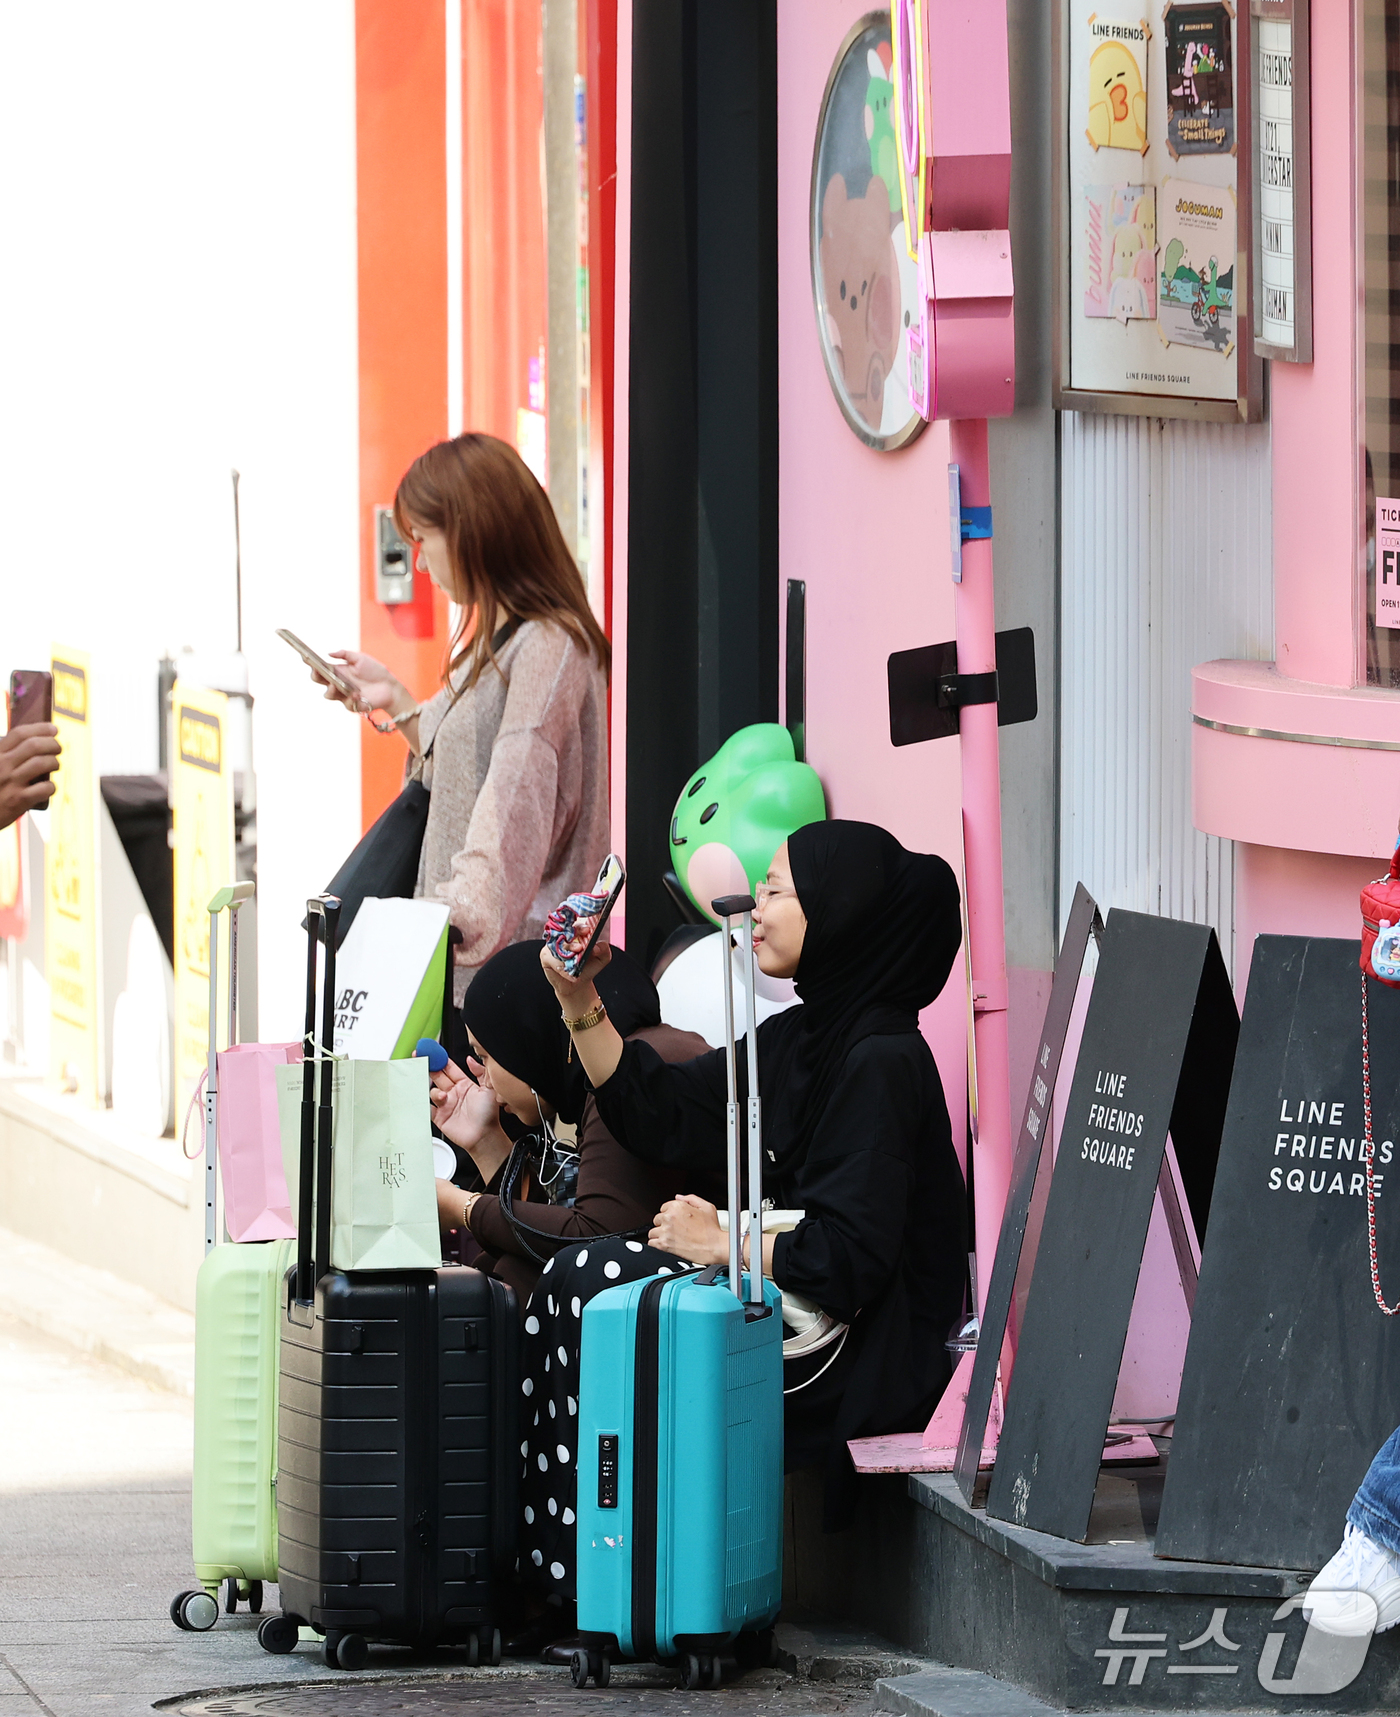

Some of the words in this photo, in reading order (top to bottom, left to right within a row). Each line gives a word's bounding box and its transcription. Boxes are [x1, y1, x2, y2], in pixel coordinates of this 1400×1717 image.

[1092, 24, 1110, 37] LINE
[1112, 26, 1144, 41] FRIENDS
[1175, 198, 1223, 220] JOGUMAN
[1125, 371, 1139, 380] LINE
[1140, 372, 1166, 382] FRIENDS
[1167, 374, 1190, 384] SQUARE
[1094, 1070, 1127, 1099] LINE
[1087, 1103, 1144, 1138] FRIENDS
[1280, 1099, 1345, 1126] LINE
[1081, 1137, 1135, 1171] SQUARE
[1274, 1133, 1394, 1164] FRIENDS
[1268, 1167, 1384, 1198] SQUARE
